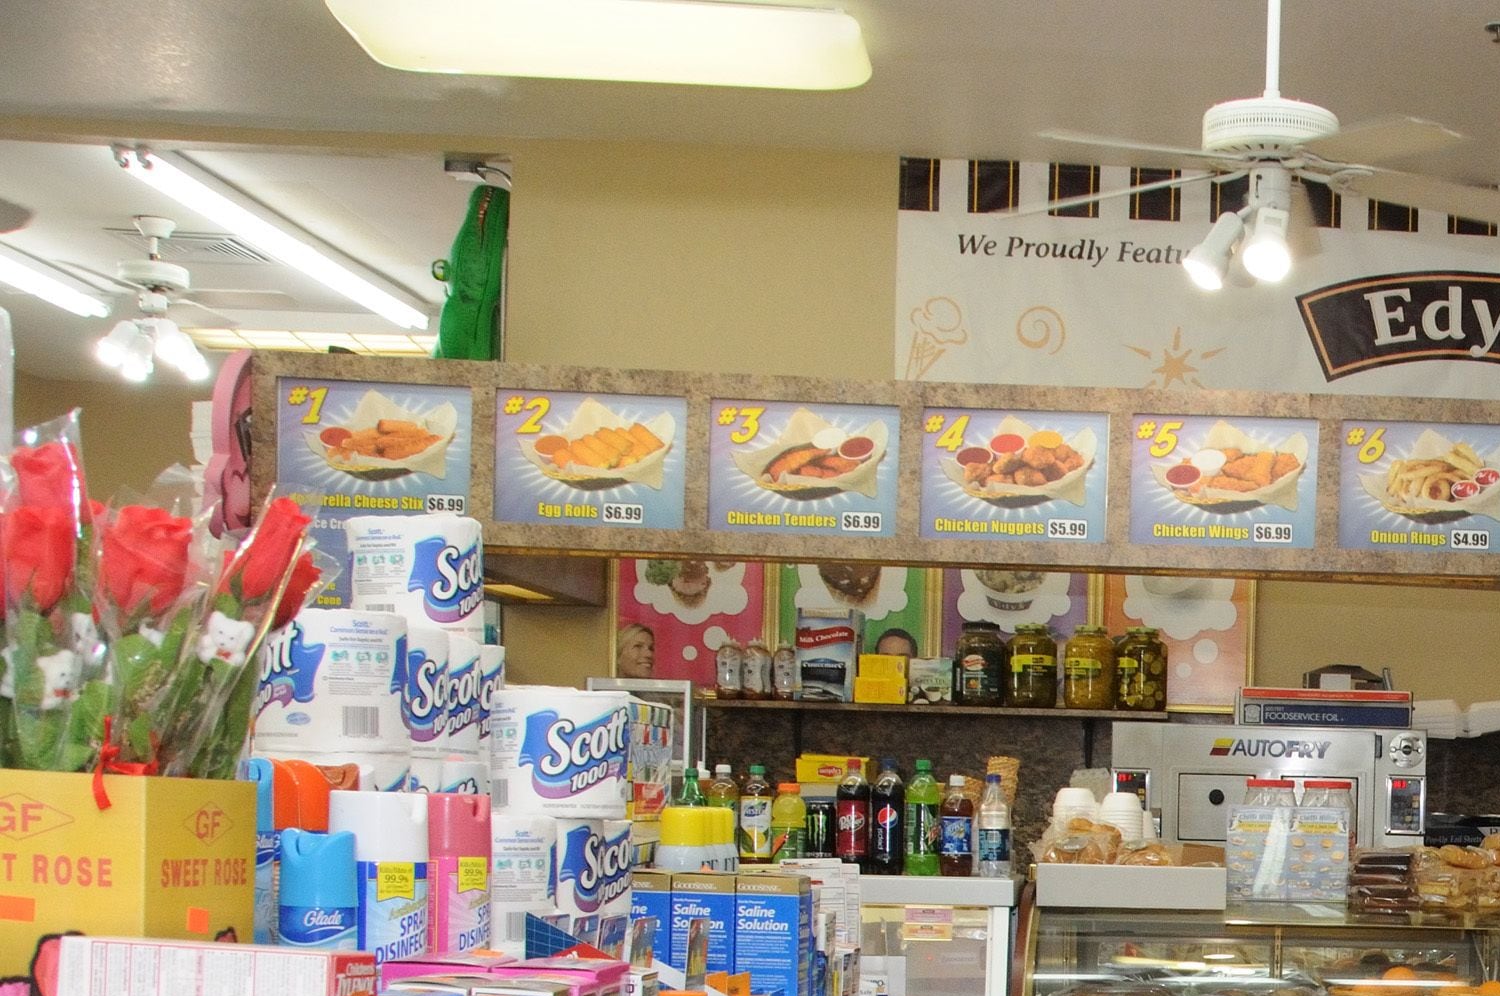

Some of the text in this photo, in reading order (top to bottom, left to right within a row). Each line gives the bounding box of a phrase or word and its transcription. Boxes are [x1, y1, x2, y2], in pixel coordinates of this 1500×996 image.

[956, 233, 1190, 266] We Proudly Featu
[288, 387, 329, 424] #1
[503, 396, 551, 435] #2
[717, 407, 765, 444] #3
[924, 415, 970, 452] #4
[1136, 420, 1182, 458] #5
[1346, 427, 1386, 464] #6
[354, 495, 399, 509] Cheese
[401, 497, 424, 510] Stix
[427, 496, 465, 512] $6.99
[538, 503, 598, 518] Egg Rolls
[604, 505, 643, 521] $6.99
[727, 510, 837, 527] Chicken Tenders
[843, 514, 880, 529] $6.99
[329, 517, 347, 530] Cre
[935, 517, 1045, 536] Chicken Nuggets
[1050, 522, 1086, 537] $5.99
[1153, 523, 1249, 541] Chicken Wings
[1255, 525, 1291, 540] $6.99
[1371, 529, 1447, 547] Onion Rings
[1452, 531, 1488, 547] $4.99
[433, 545, 482, 600] Sco
[815, 630, 849, 642] Chocolate
[1264, 711, 1339, 722] FOODSERVICE FOIL
[540, 706, 629, 776] Scott
[1232, 739, 1332, 760] AUTOFRY
[570, 761, 608, 793] 1000
[195, 810, 223, 840] GF
[32, 857, 113, 888] ROSE
[161, 857, 248, 888] SWEET ROSE
[302, 907, 345, 930] Glade
[673, 903, 711, 917] Saline
[737, 905, 776, 919] Saline
[672, 916, 724, 930] Solon
[737, 917, 789, 932] Solution
[375, 928, 427, 966] DISINFEC
